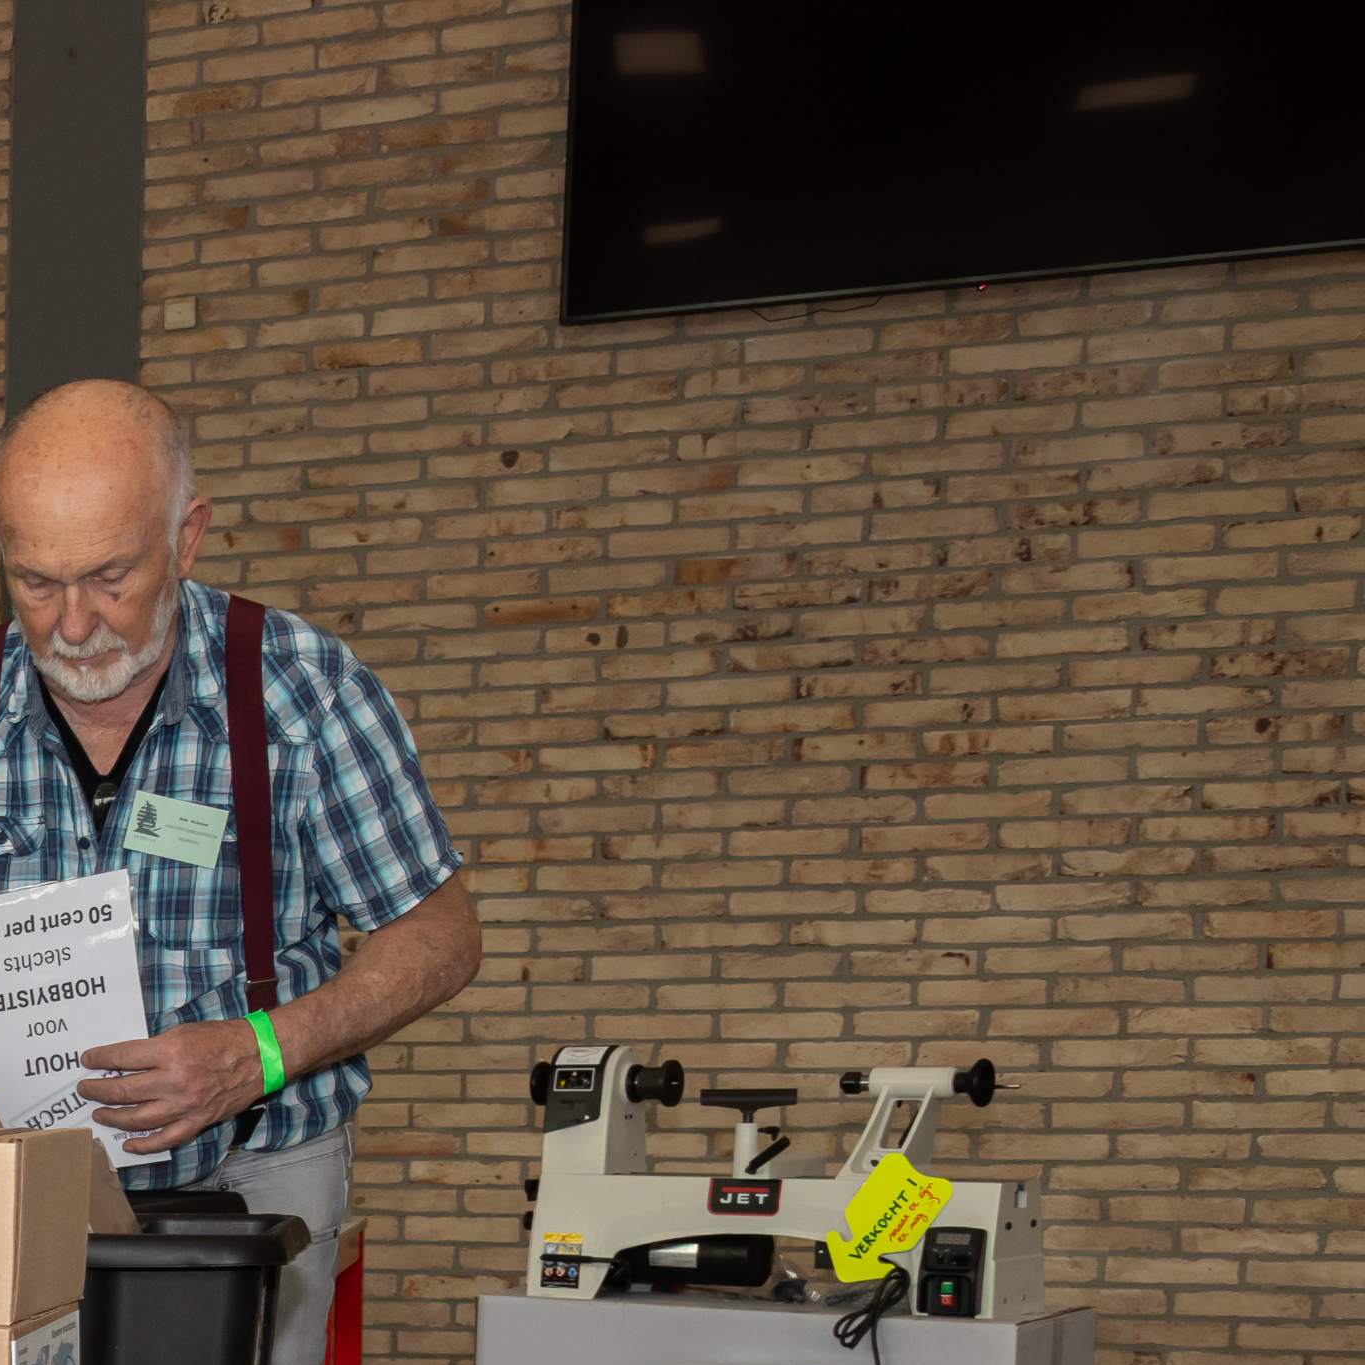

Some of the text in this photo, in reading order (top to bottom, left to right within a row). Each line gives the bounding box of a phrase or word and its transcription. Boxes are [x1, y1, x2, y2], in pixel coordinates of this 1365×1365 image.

[39, 911, 84, 934] cent
[88, 903, 113, 924] 50
[4, 915, 35, 938] per
[3, 946, 72, 972] slechts
[26, 1018, 68, 1038] voor
[24, 1051, 81, 1077] HOUT
[24, 1090, 88, 1131] TISCH
[719, 1192, 769, 1205] JET
[848, 1190, 909, 1260] VERKOCHT
